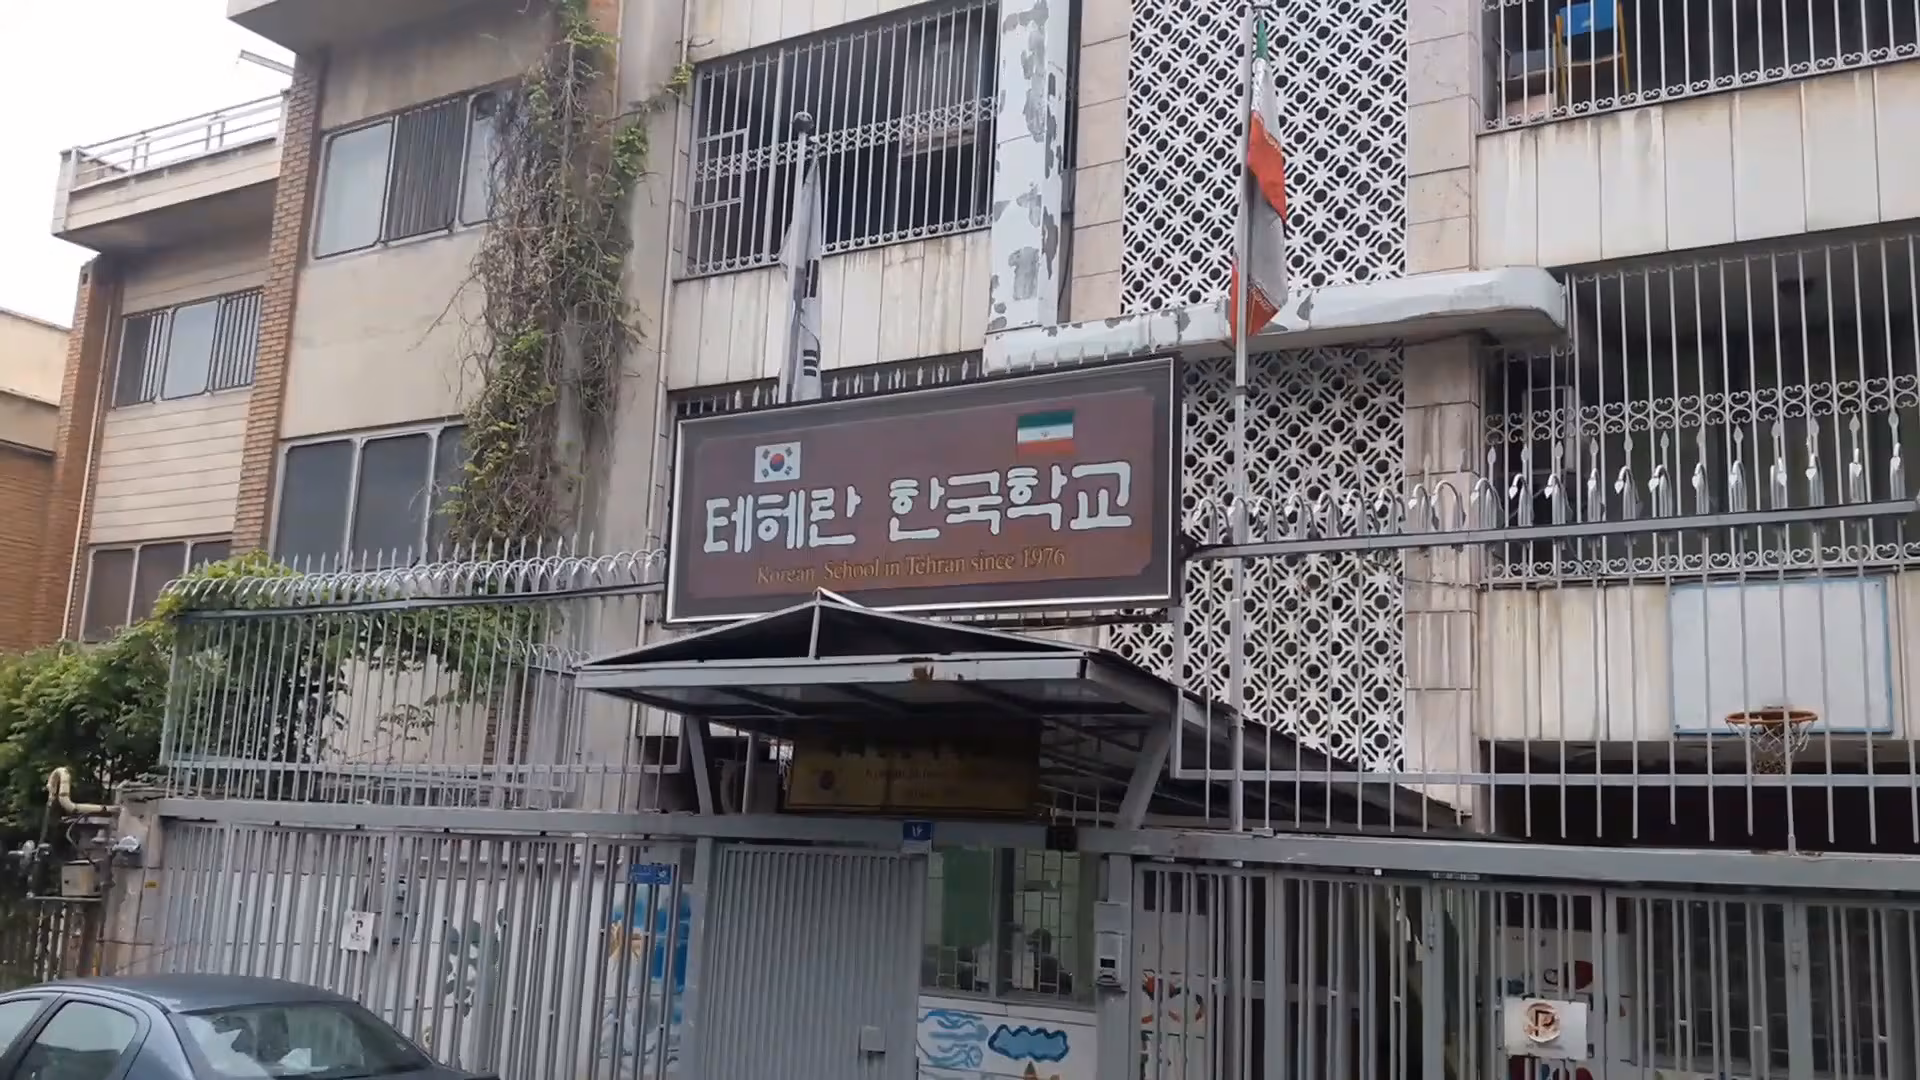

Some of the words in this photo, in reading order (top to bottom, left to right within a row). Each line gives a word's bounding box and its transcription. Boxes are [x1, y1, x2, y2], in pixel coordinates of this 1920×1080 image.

[703, 485, 862, 553] 테헤란
[889, 460, 1133, 542] 한국학교
[756, 563, 815, 584] Korean
[824, 556, 879, 580] School
[885, 558, 900, 577] in
[905, 553, 965, 576] Tehran
[970, 549, 1015, 571] since
[1021, 544, 1066, 568] 1976
